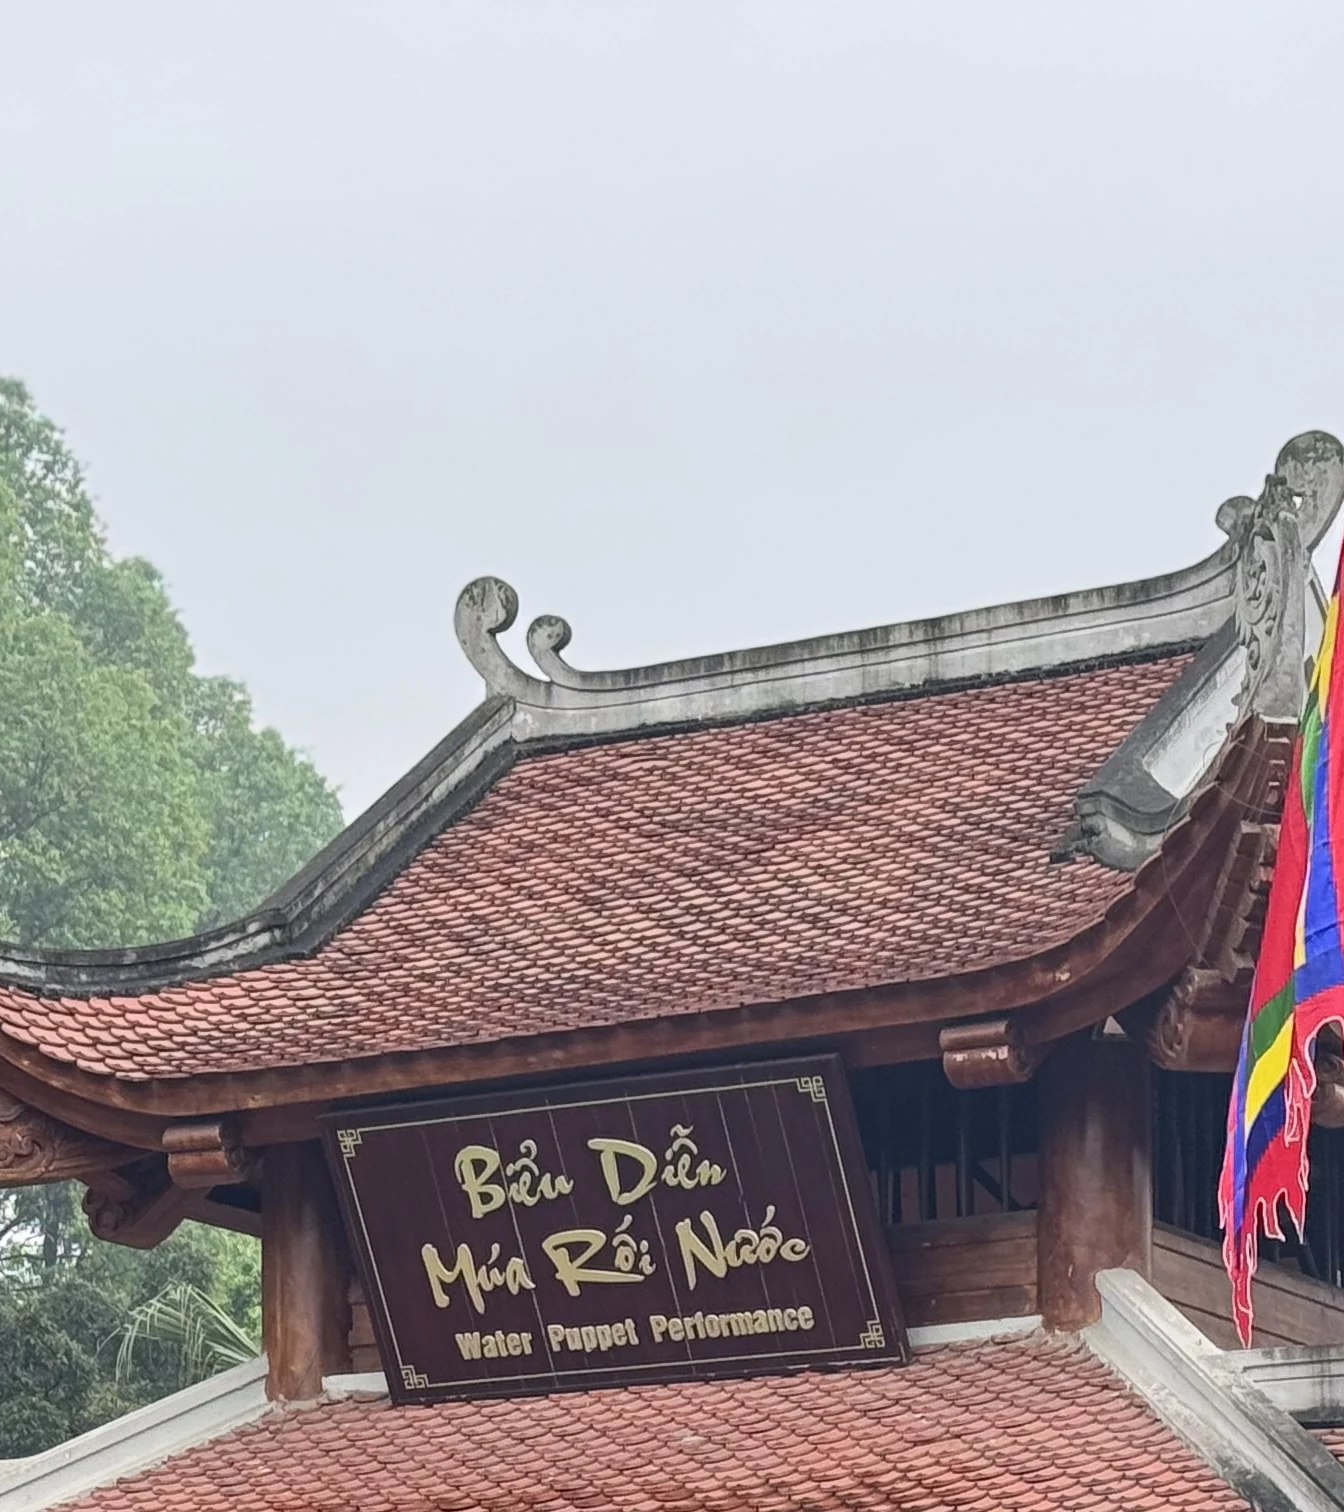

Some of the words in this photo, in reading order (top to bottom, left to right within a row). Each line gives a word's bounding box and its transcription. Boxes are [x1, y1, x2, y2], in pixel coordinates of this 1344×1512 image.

[454, 1139, 574, 1219] Biểu
[587, 1123, 727, 1206] Diễn
[421, 1242, 536, 1314] Múa
[541, 1214, 656, 1297] Rối
[675, 1204, 811, 1291] Nước
[455, 1330, 533, 1360] Water
[547, 1318, 639, 1353] Puppet
[649, 1305, 815, 1343] Performance
